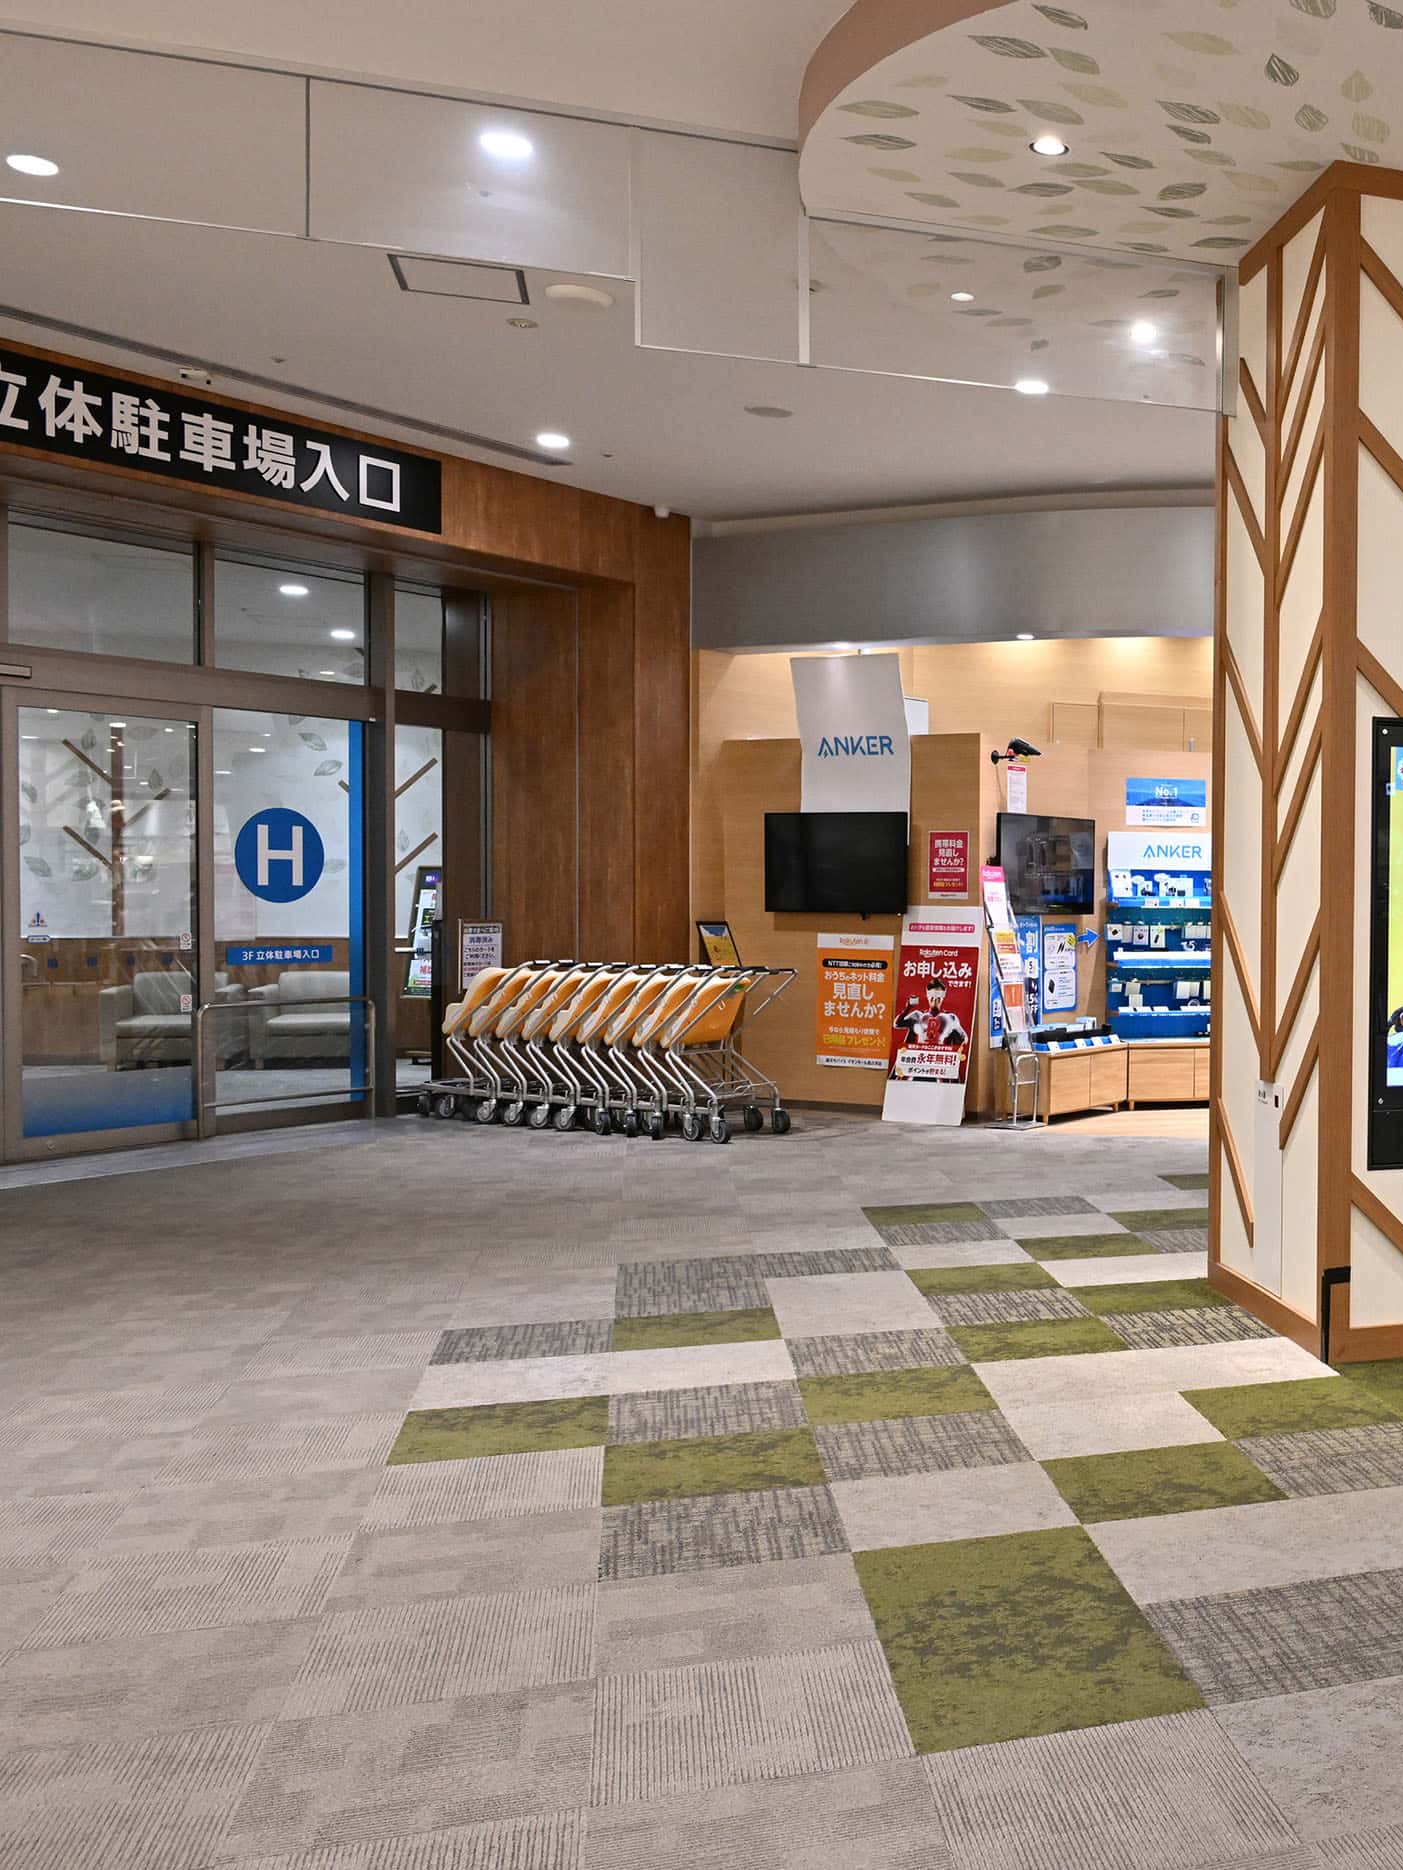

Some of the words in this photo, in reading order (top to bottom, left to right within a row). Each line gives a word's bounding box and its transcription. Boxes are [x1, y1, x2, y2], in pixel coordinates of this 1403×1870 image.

[817, 735, 895, 758] ANKER
[256, 824, 304, 886] H
[1143, 844, 1202, 859] ANKER
[242, 951, 254, 960] 3F
[256, 949, 320, 960] 立体駐車場入口
[903, 961, 973, 979] お申し込み
[833, 982, 874, 1001] 見直し
[823, 1000, 886, 1020] ませんか?
